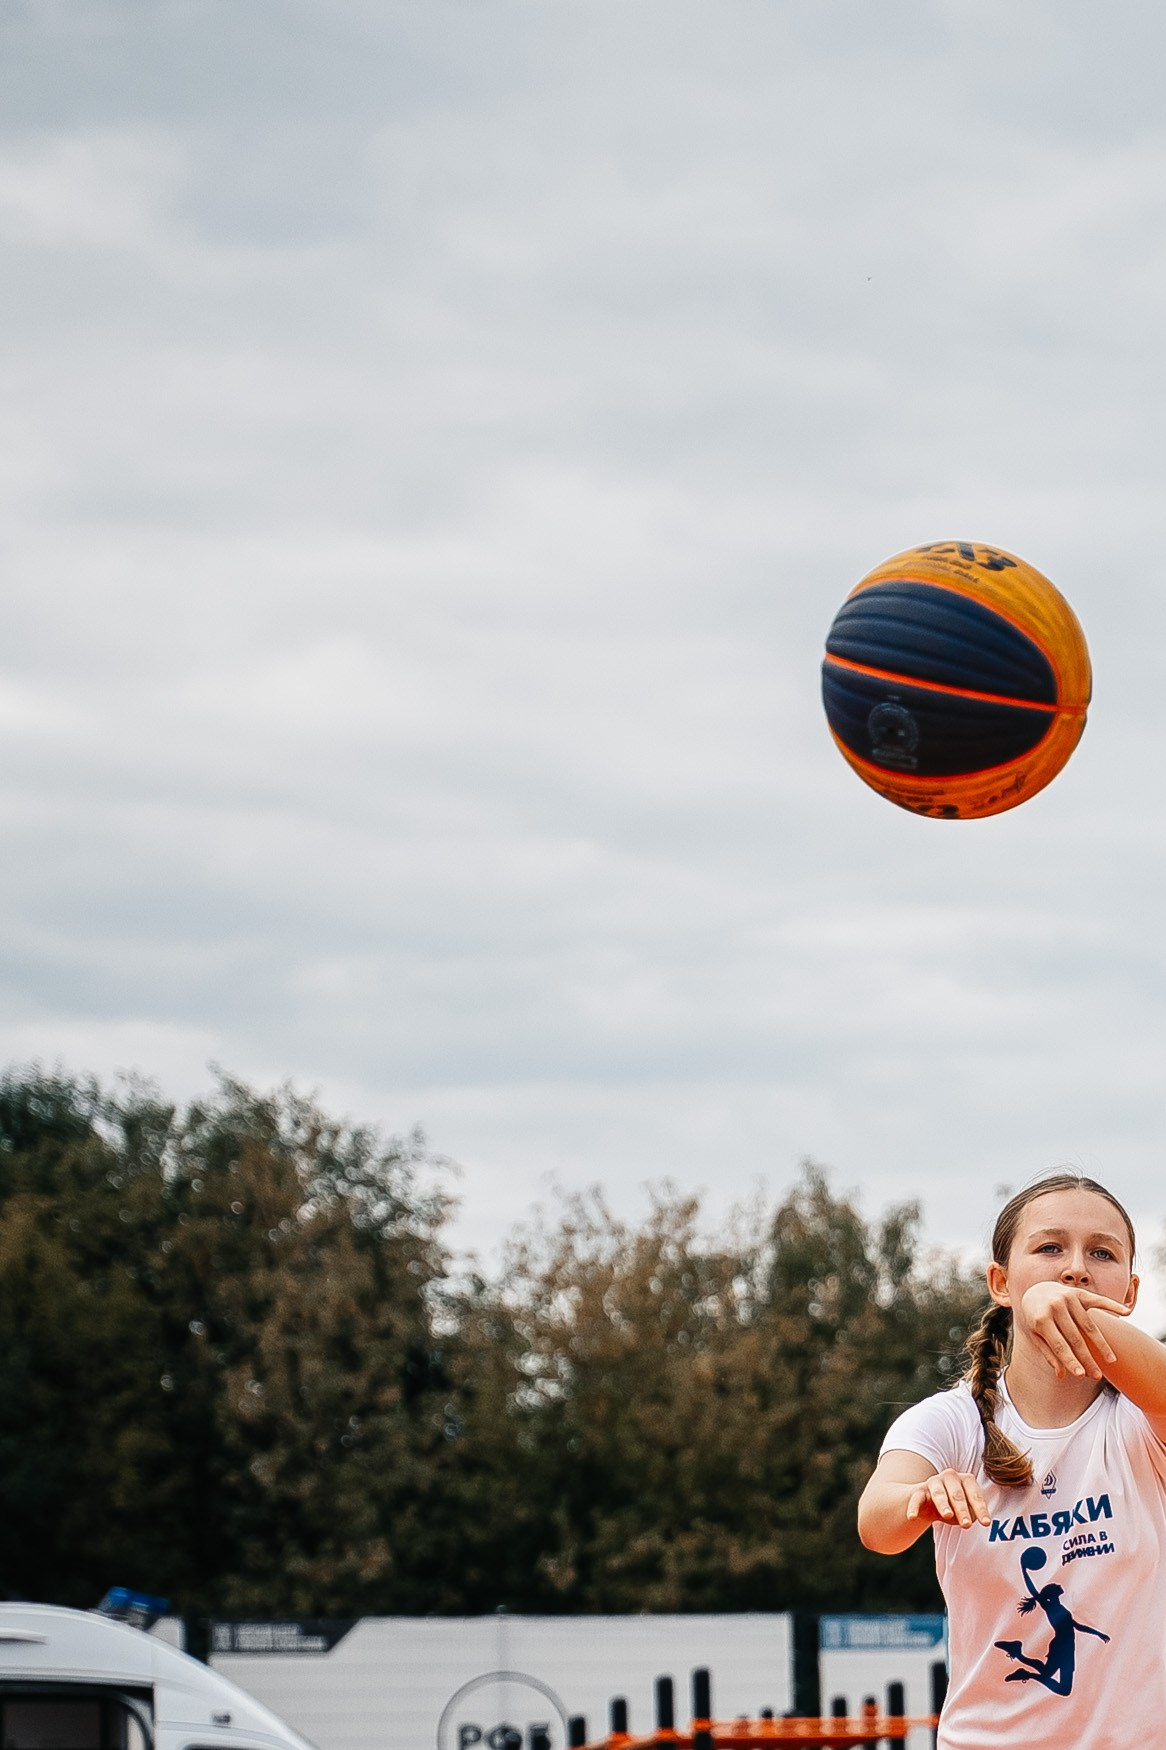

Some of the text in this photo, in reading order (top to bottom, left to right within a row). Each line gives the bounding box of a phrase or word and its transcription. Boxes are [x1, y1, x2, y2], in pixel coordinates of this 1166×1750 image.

[988, 1493, 1113, 1542] КАБЯКИ
[1062, 1530, 1108, 1551] СИЛА В
[1061, 1542, 1115, 1566] ДВИЖЕНИИ
